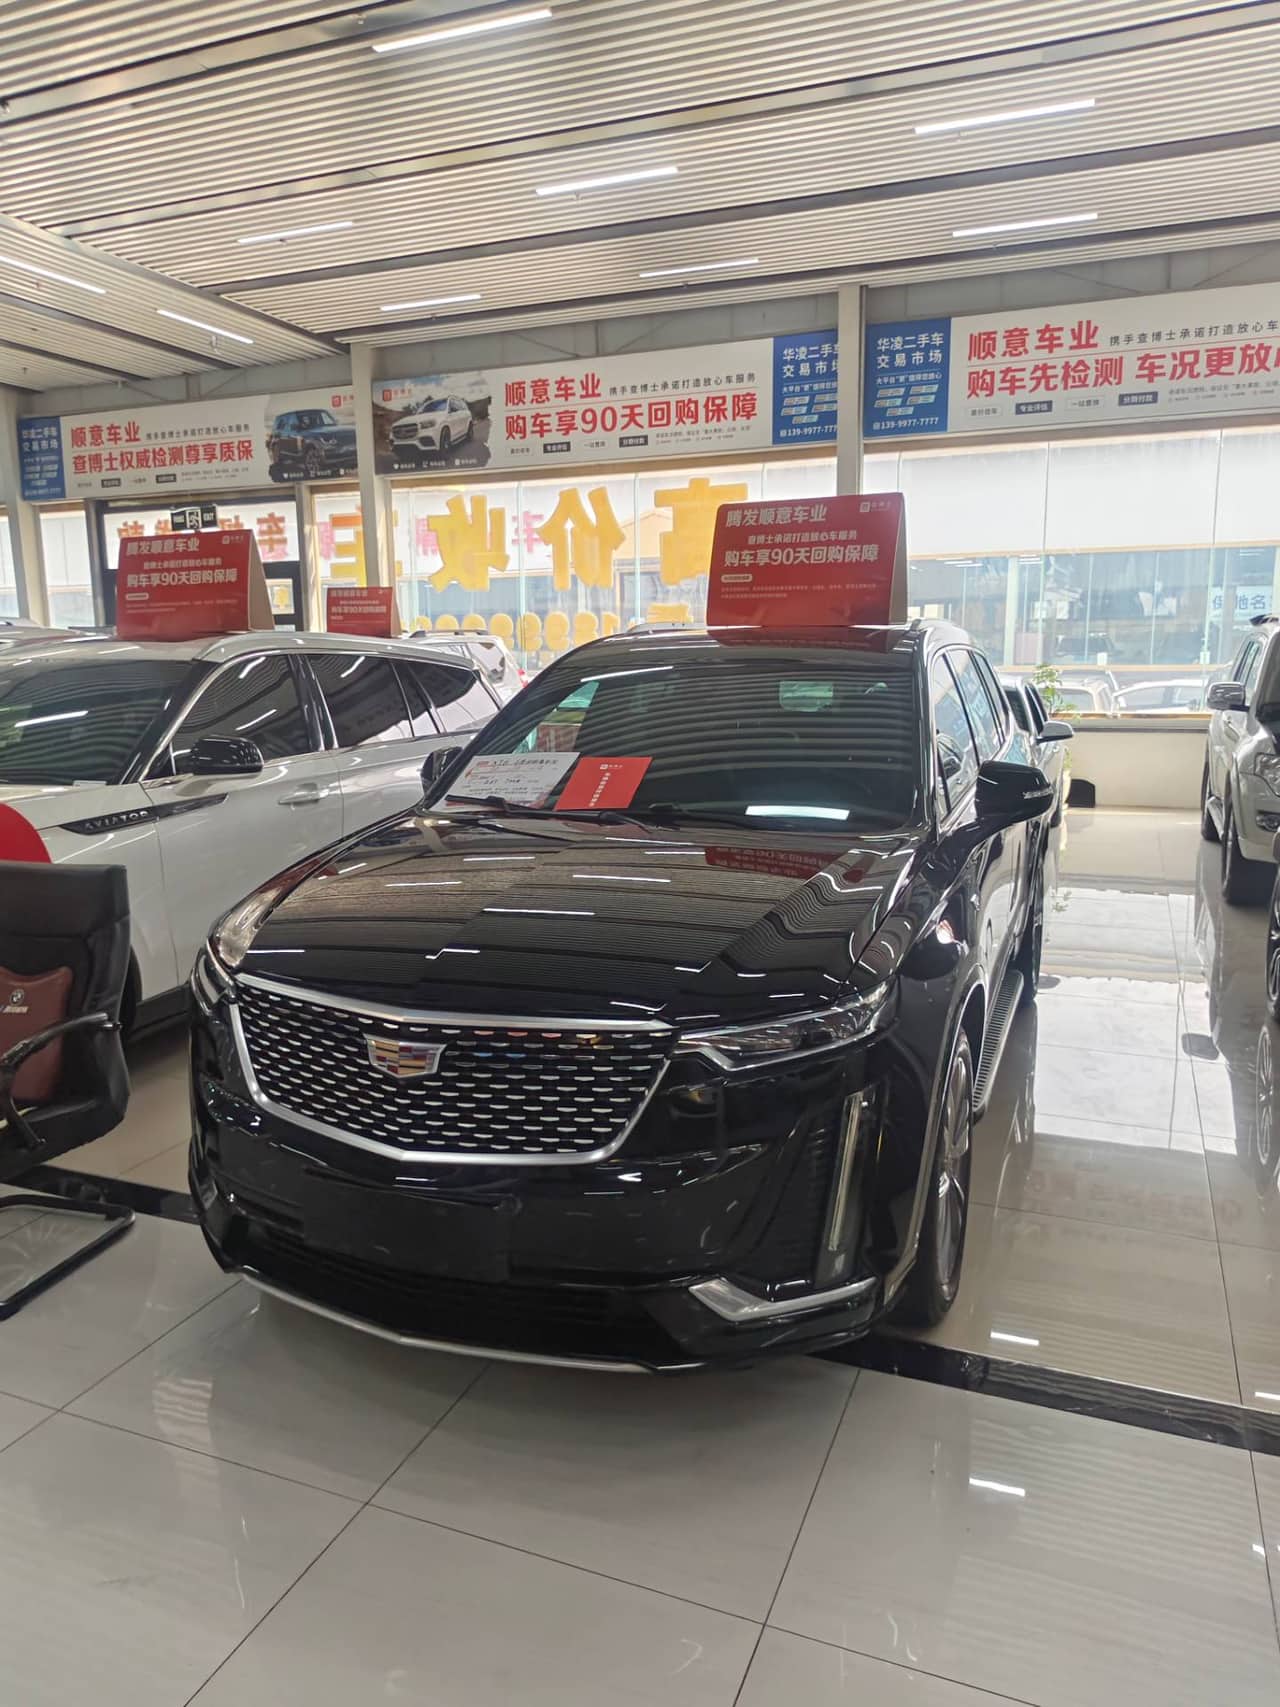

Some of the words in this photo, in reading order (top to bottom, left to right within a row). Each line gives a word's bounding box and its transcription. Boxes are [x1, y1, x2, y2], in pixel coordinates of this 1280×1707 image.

[877, 332, 944, 351] 华凌二手车
[968, 320, 1099, 361] 顺意车业
[877, 351, 942, 369] 交易市场
[967, 355, 1124, 400] 购车先检测
[1135, 343, 1280, 383] 车况更放
[505, 373, 601, 407] 顺意车业
[609, 372, 756, 396] 携手查博士承诺打造放心车服务
[505, 392, 758, 440] 购车享90天回购保障
[71, 421, 141, 448] 顺意车业
[73, 440, 253, 475] 查博士权威检测尊享质保
[726, 504, 827, 528] 腾发顺意车业
[724, 544, 879, 567] 购车享90天回购保障
[85, 811, 149, 829] AVIATOR
